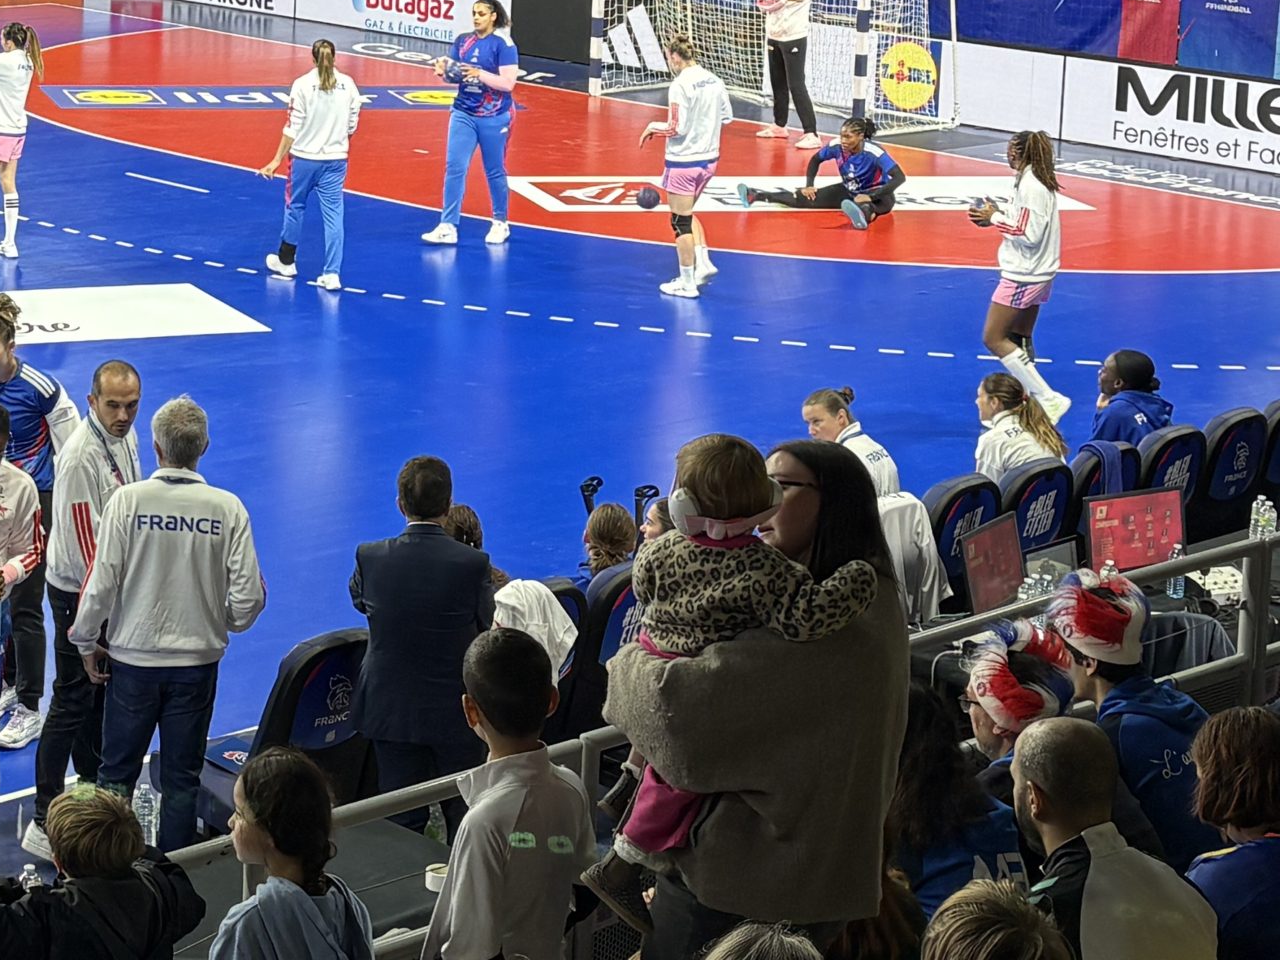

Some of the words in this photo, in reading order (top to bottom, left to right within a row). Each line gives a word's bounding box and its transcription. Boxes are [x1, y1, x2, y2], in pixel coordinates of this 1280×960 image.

[364, 18, 384, 30] GAZ
[1113, 121, 1209, 155] Fenêtres
[1216, 138, 1240, 159] et
[314, 711, 351, 728] FRANC
